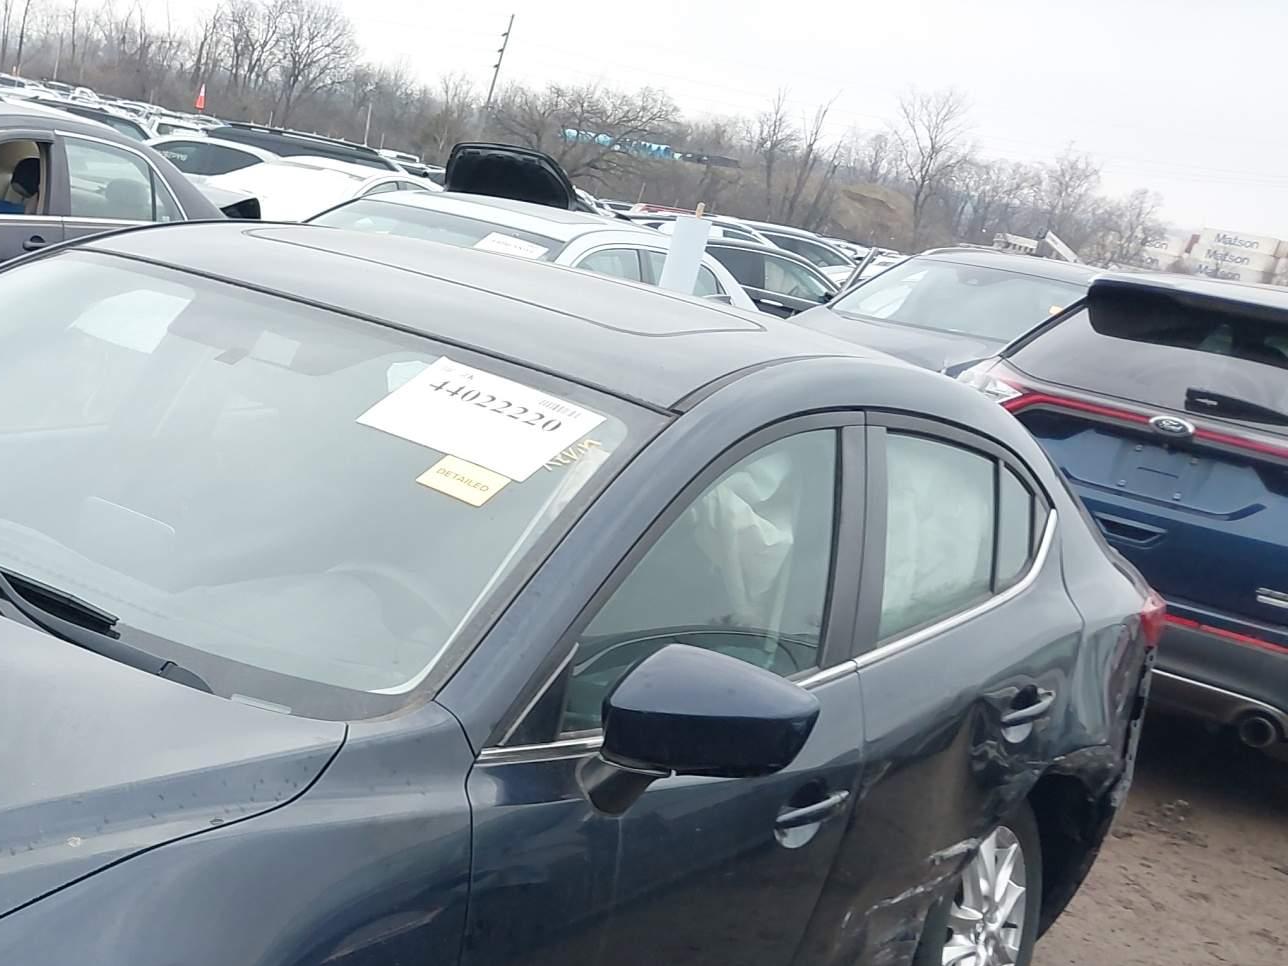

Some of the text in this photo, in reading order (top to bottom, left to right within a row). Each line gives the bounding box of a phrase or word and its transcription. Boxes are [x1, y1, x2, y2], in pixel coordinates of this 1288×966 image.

[1215, 232, 1260, 249] Matson
[1205, 248, 1251, 265] Matson
[429, 380, 562, 432] 44022220
[436, 467, 490, 493] DETAILED
